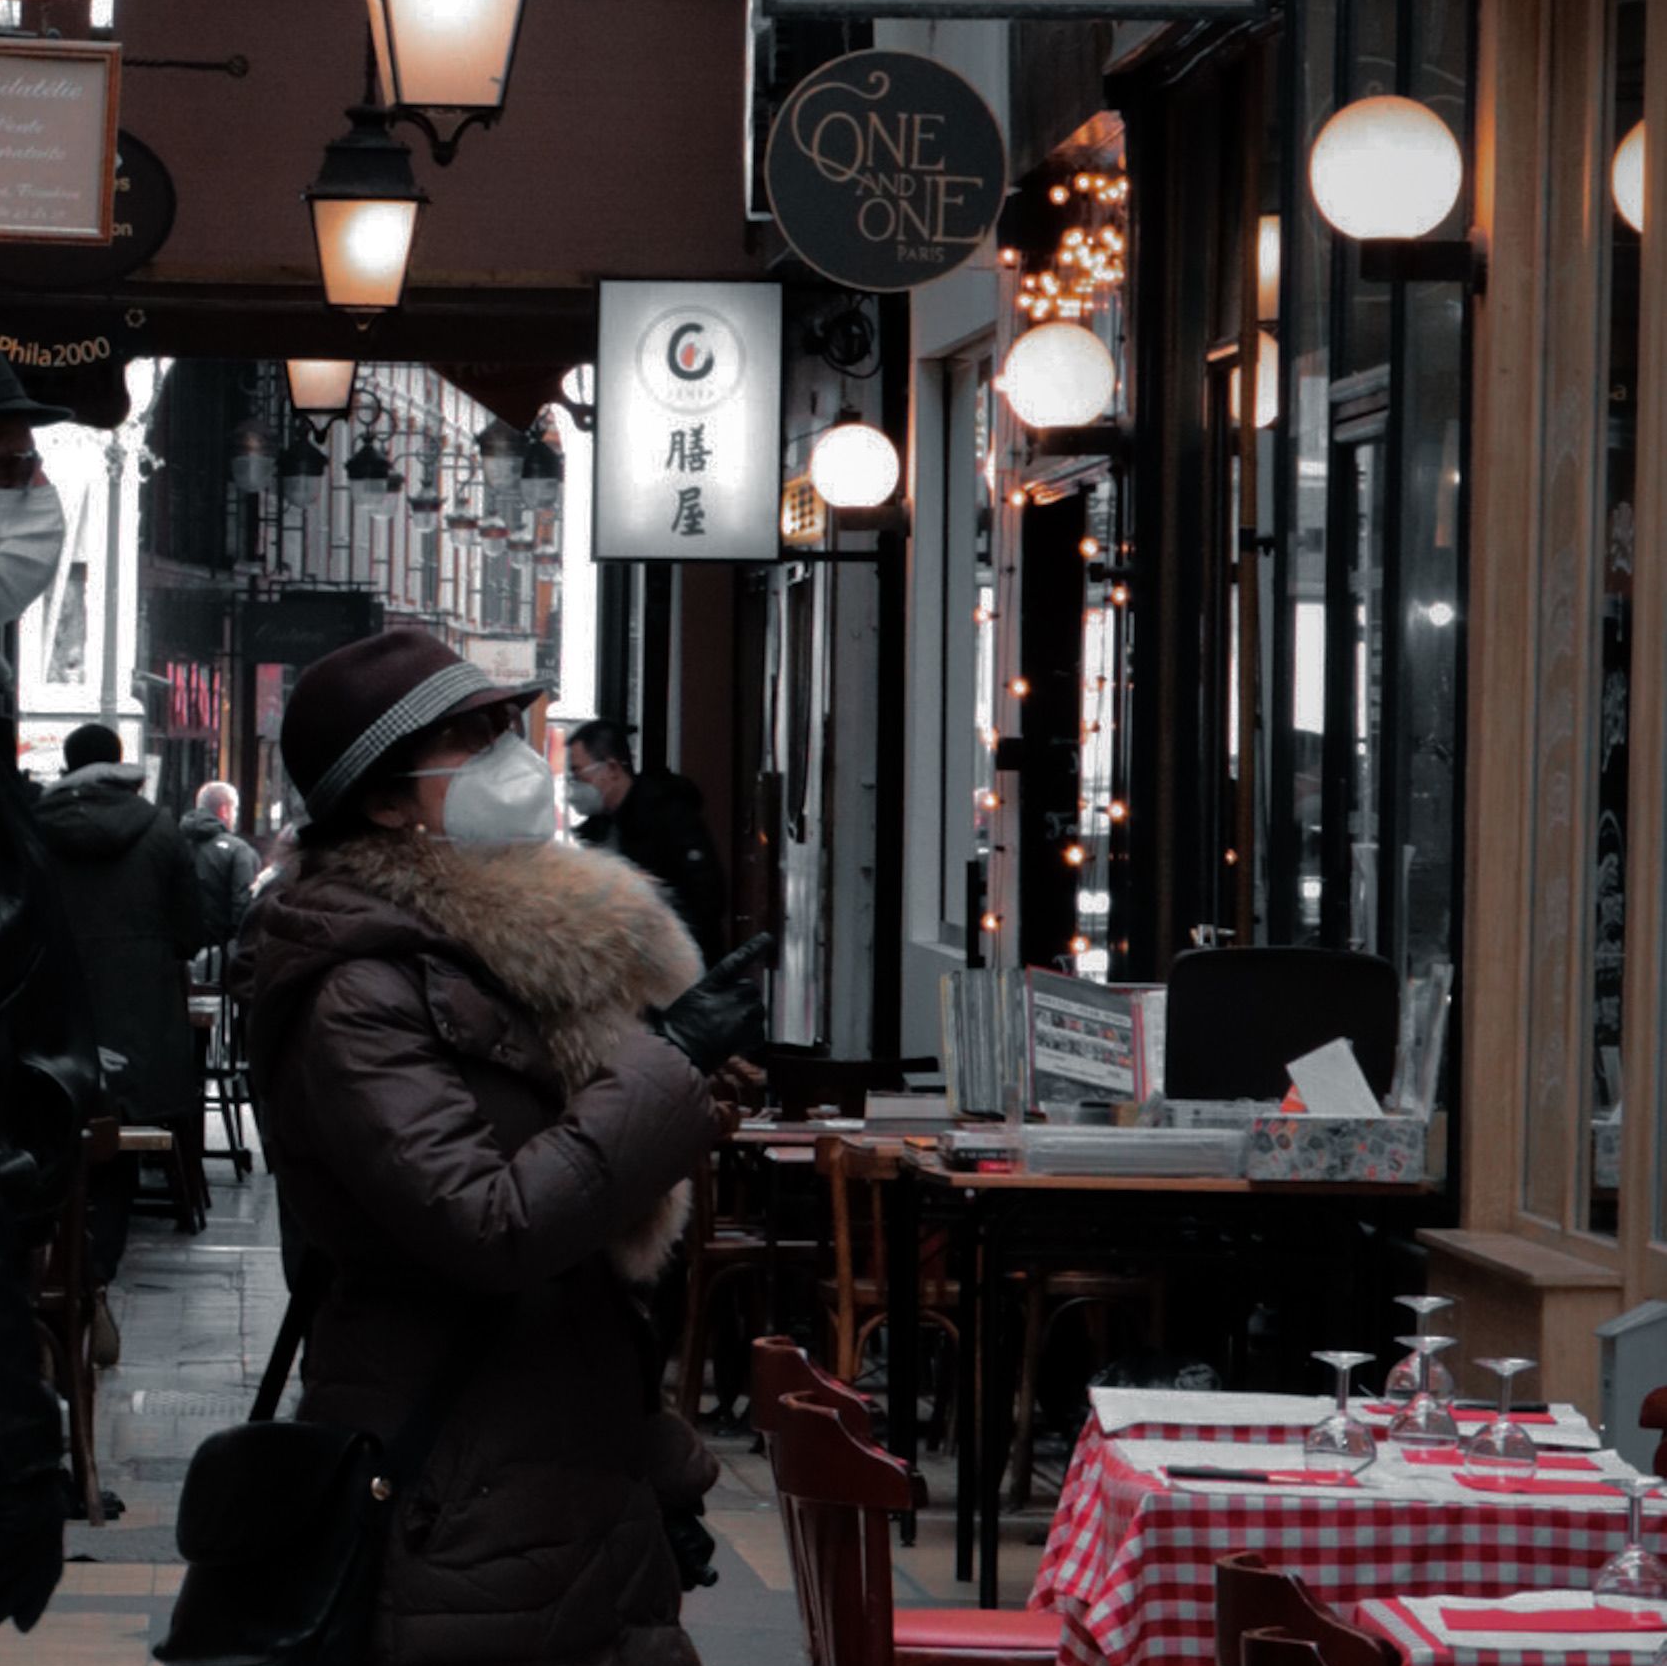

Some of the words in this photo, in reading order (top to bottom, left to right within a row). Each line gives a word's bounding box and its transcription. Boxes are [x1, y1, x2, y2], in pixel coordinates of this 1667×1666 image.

[790, 70, 947, 184] ONE
[855, 174, 917, 198] AND
[858, 175, 987, 245] ONE
[896, 245, 946, 264] PARIS
[665, 421, 713, 537] 膳屋
